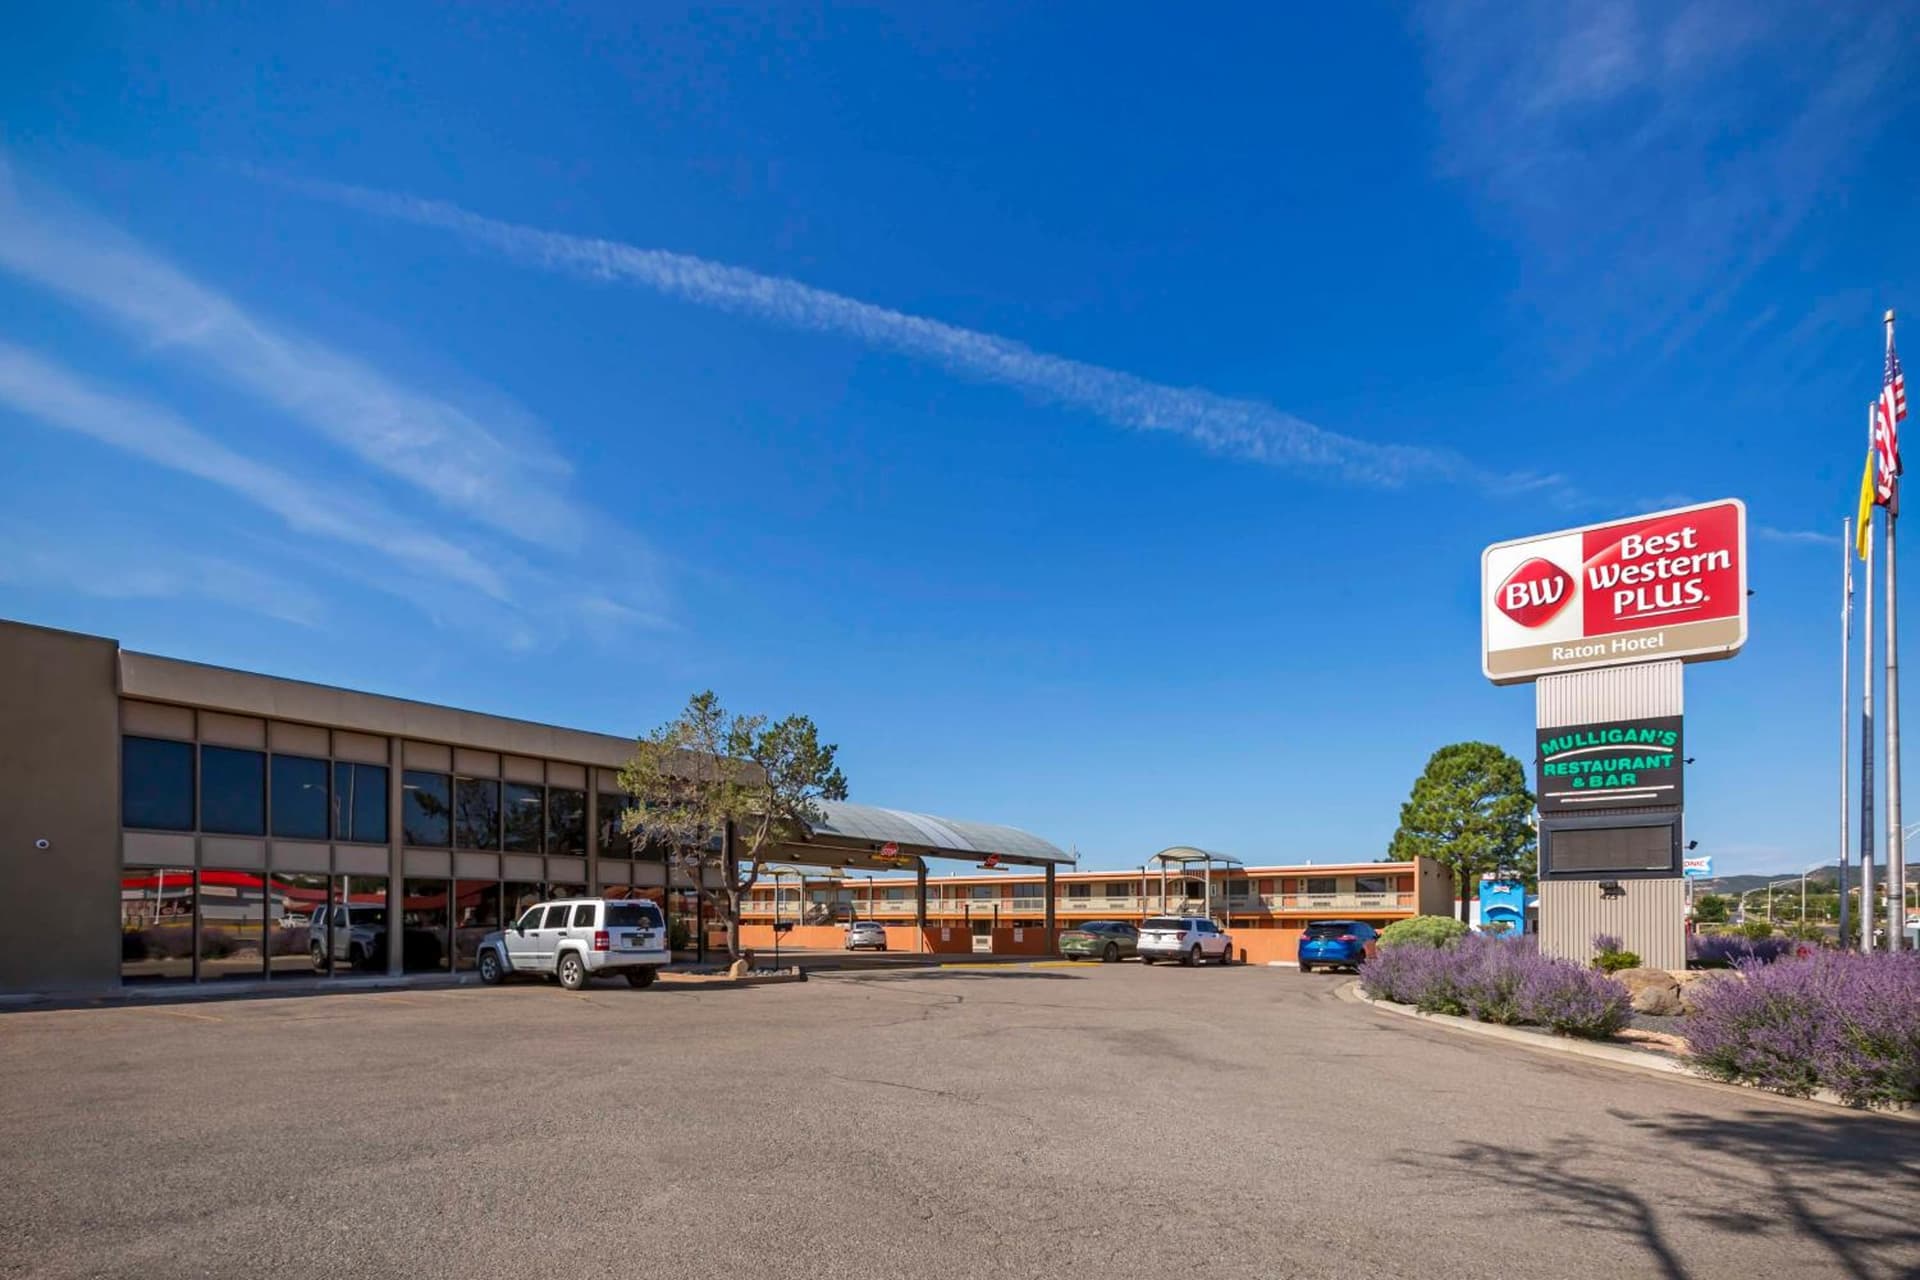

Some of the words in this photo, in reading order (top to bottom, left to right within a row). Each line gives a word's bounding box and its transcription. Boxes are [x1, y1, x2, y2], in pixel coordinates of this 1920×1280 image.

[1620, 526, 1697, 561] Best
[1587, 549, 1731, 590] Western
[1506, 576, 1564, 610] BW
[1552, 643, 1606, 661] Raton
[1611, 633, 1664, 654] Hotel
[1541, 728, 1678, 756] MULLIGAN'S
[1543, 754, 1675, 777] RESTAURANT
[1572, 777, 1585, 788] &
[1589, 773, 1636, 788] BAR
